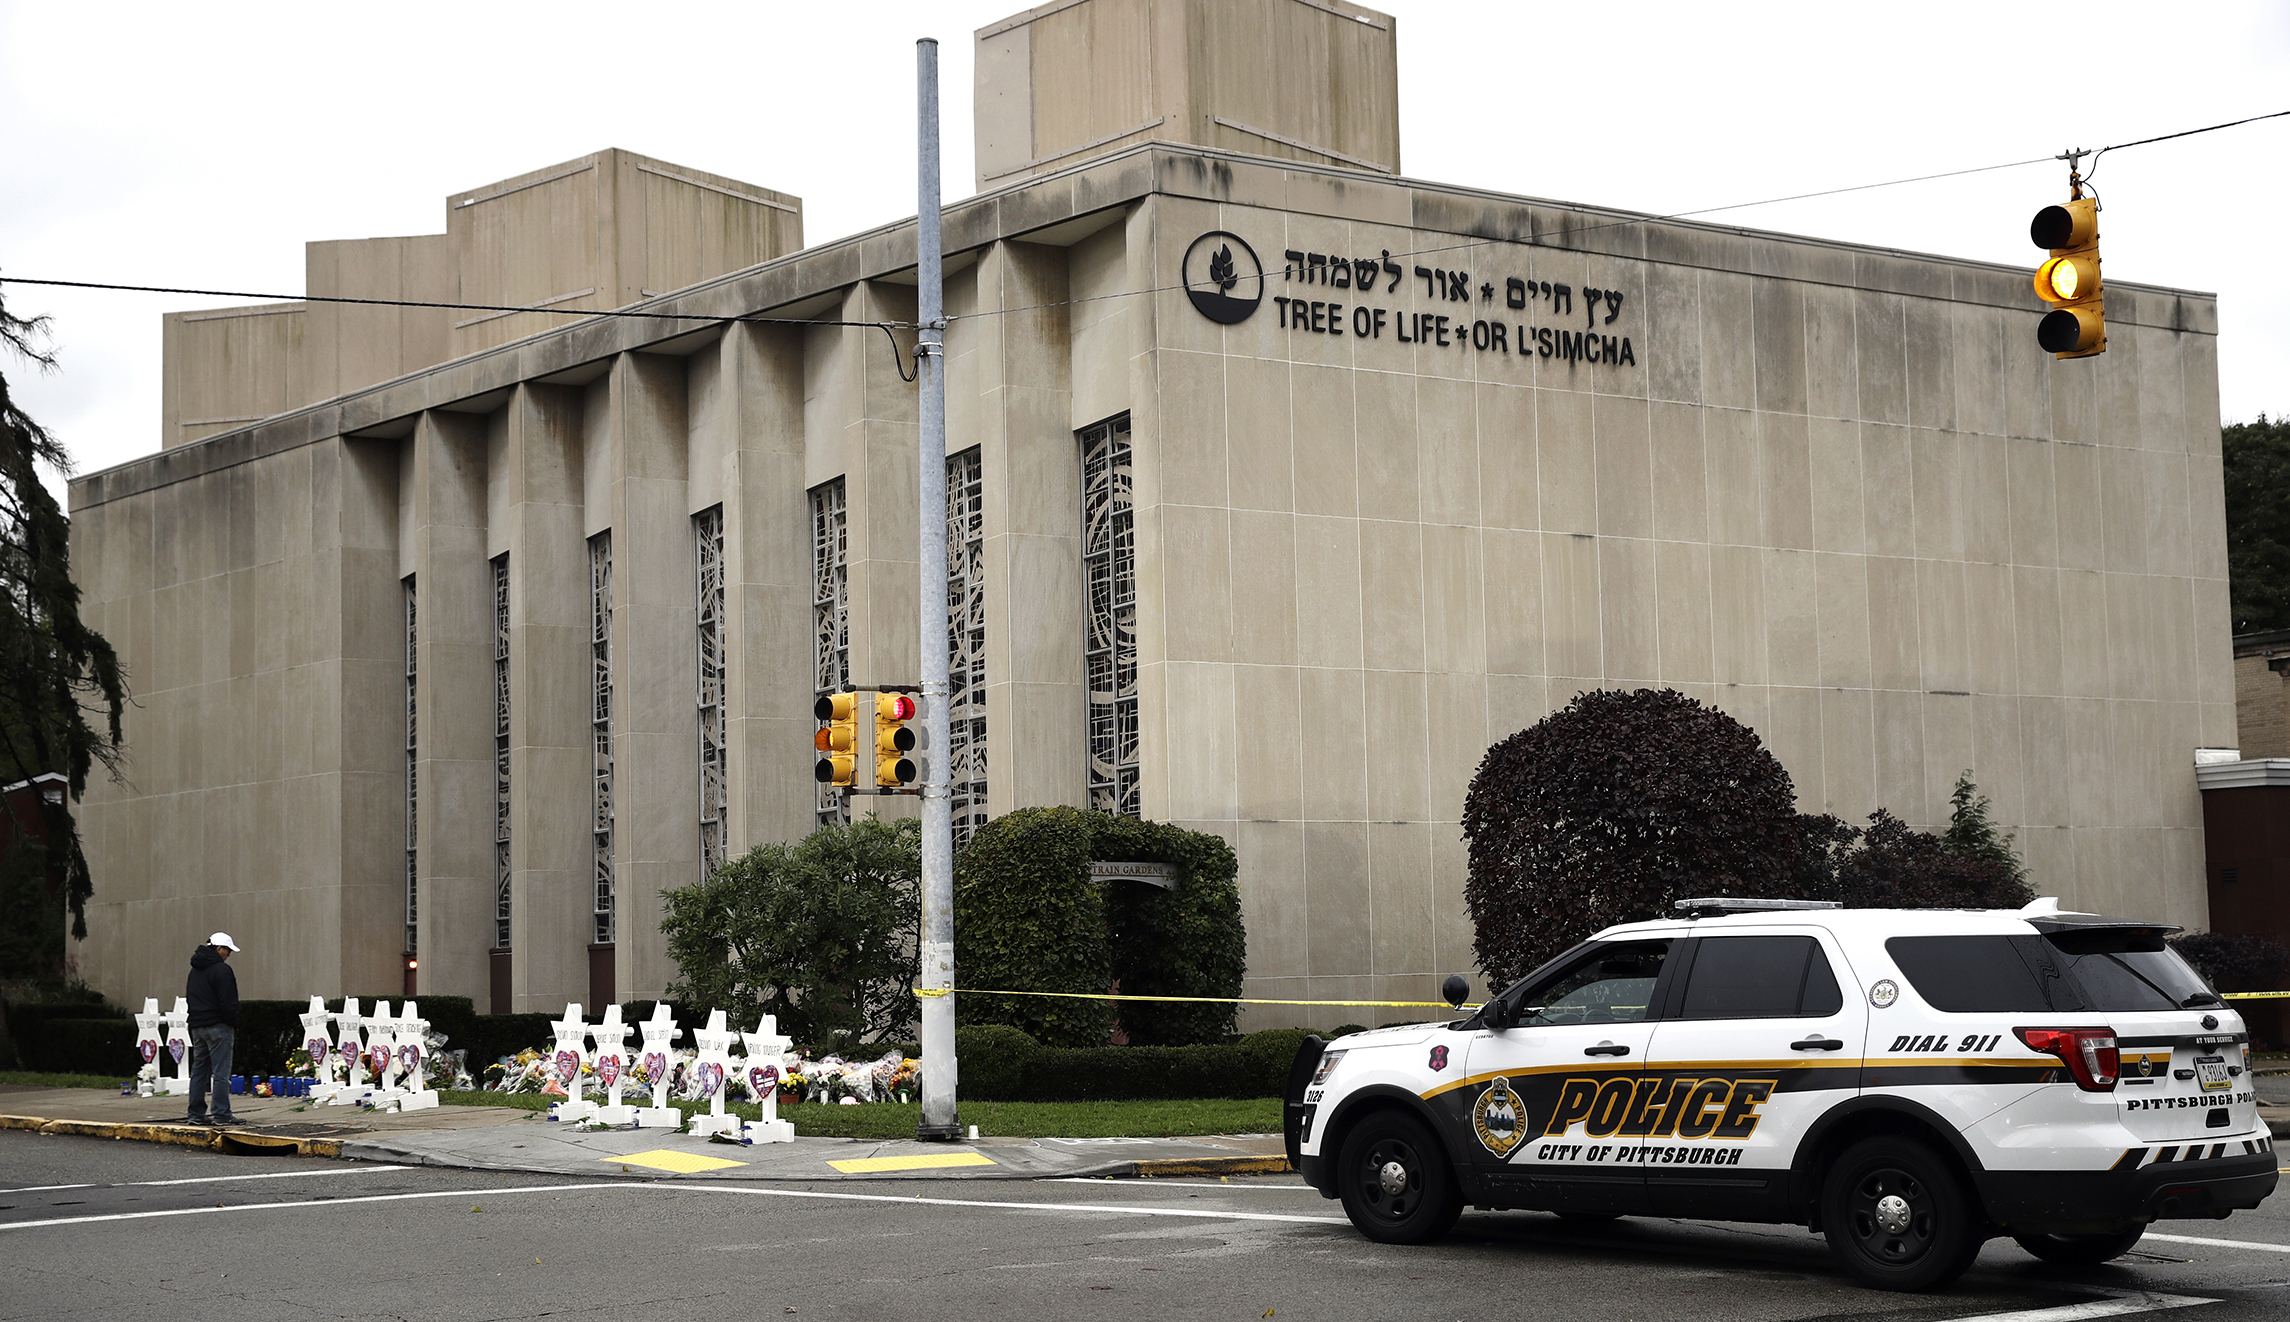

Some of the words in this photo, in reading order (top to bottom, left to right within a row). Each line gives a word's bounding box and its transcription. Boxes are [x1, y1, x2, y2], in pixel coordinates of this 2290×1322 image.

[1285, 249, 1402, 293] לשמחה
[1415, 265, 1470, 302] אור
[1507, 277, 1572, 315] חיים
[1583, 287, 1624, 328] עץ
[1274, 297, 1344, 335] TREE
[1353, 306, 1386, 339] OF
[1397, 311, 1450, 346] LIFE
[1473, 320, 1508, 352] OR
[1518, 325, 1636, 367] L'SIMCHA
[1122, 865, 1163, 875] GARDENS
[1889, 1035, 1949, 1052] DIAL
[1957, 1034, 2002, 1052] 911
[2204, 1036, 2215, 1044] YOUR
[2216, 1035, 2234, 1043] SERVICE
[1306, 1090, 1325, 1103] 3126
[1543, 1077, 1778, 1140] POLICE
[2127, 1094, 2233, 1111] PITTSBURGH
[1475, 1097, 1489, 1140] PITTSBURGH
[1515, 1106, 1524, 1134] POLICE
[1537, 1144, 1583, 1161] CITY
[1586, 1145, 1616, 1162] OF
[1615, 1146, 1744, 1166] PITTSBURGH
